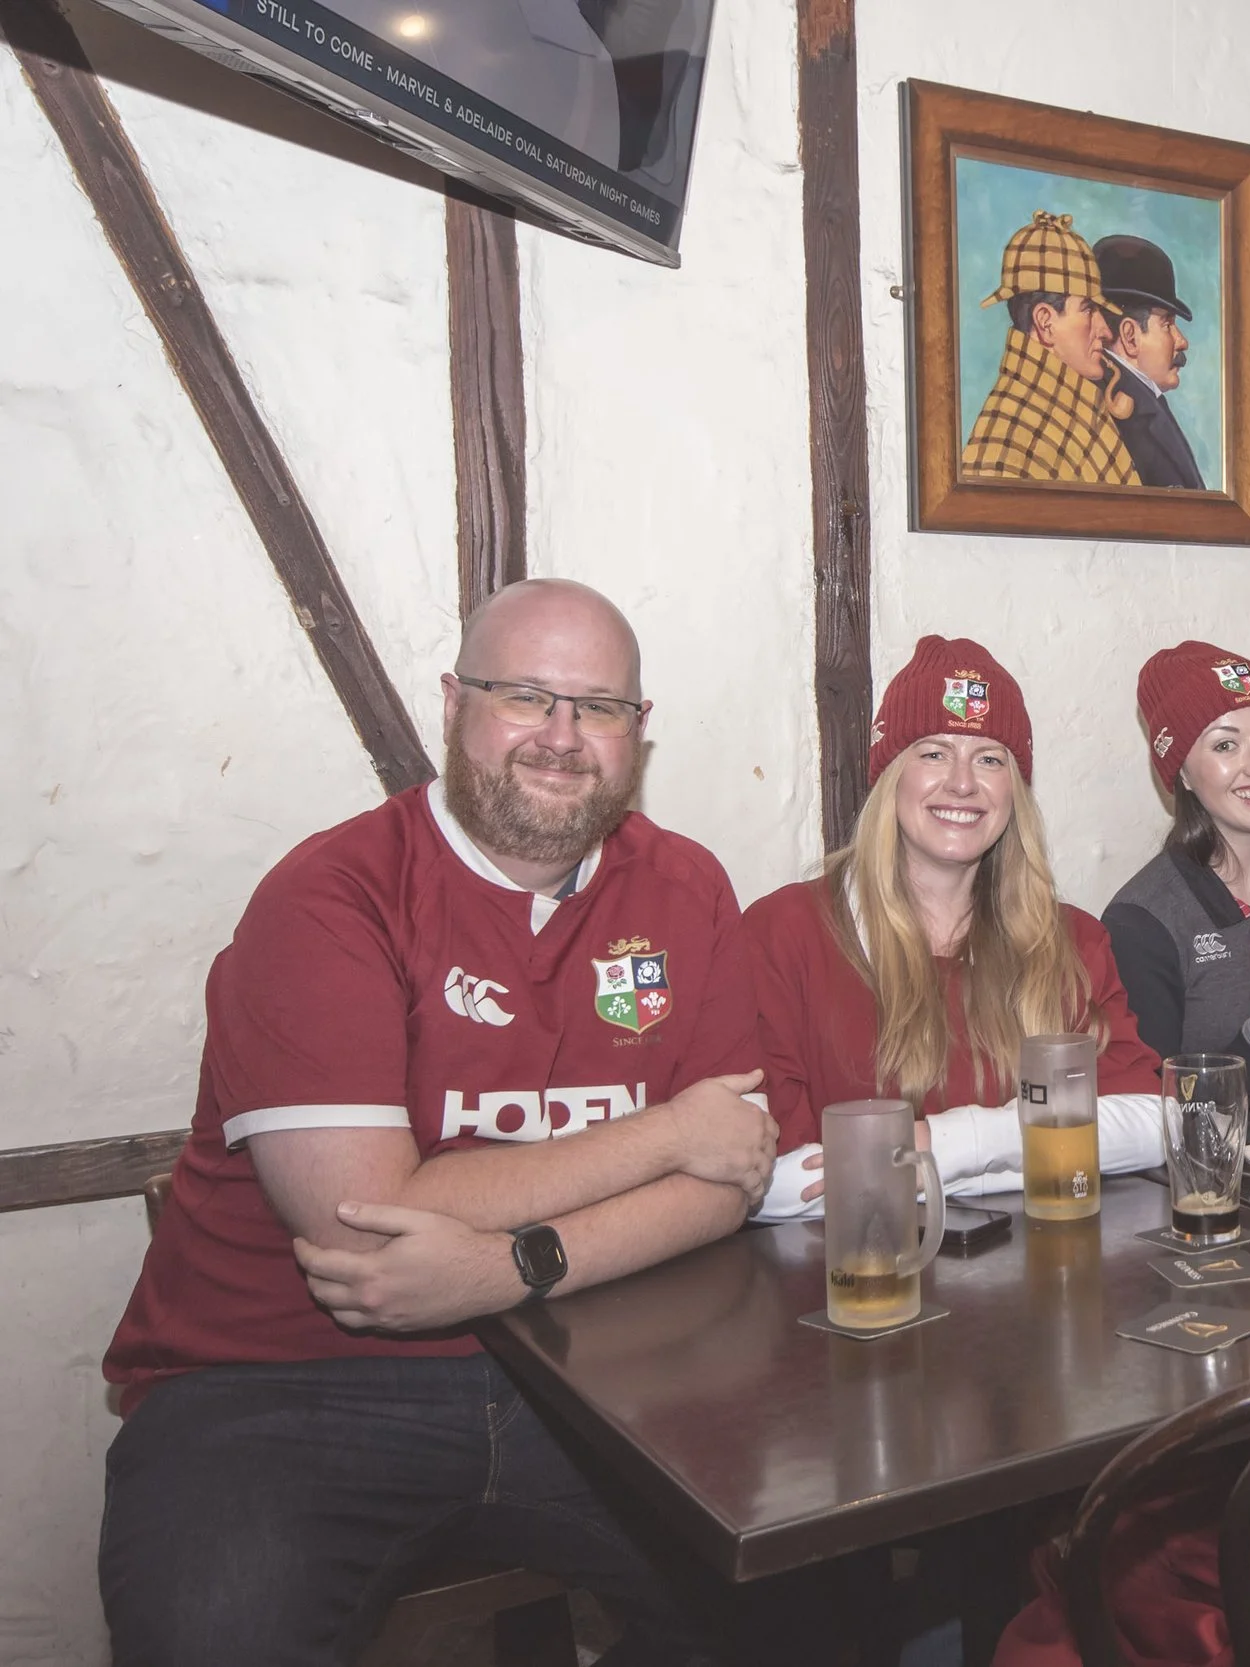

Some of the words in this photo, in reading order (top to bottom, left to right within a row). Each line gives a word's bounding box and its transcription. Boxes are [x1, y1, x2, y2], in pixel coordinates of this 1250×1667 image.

[256, 0, 299, 32] STILL
[305, 20, 325, 45] TO
[330, 35, 374, 71] COME
[387, 66, 440, 107] MARVEL
[444, 97, 453, 113] &
[456, 105, 513, 146] ADELAIDE
[515, 136, 543, 163] OVAL
[546, 153, 598, 191] SATURDAY
[600, 183, 628, 207] NIGHT
[630, 199, 661, 225] GAMES
